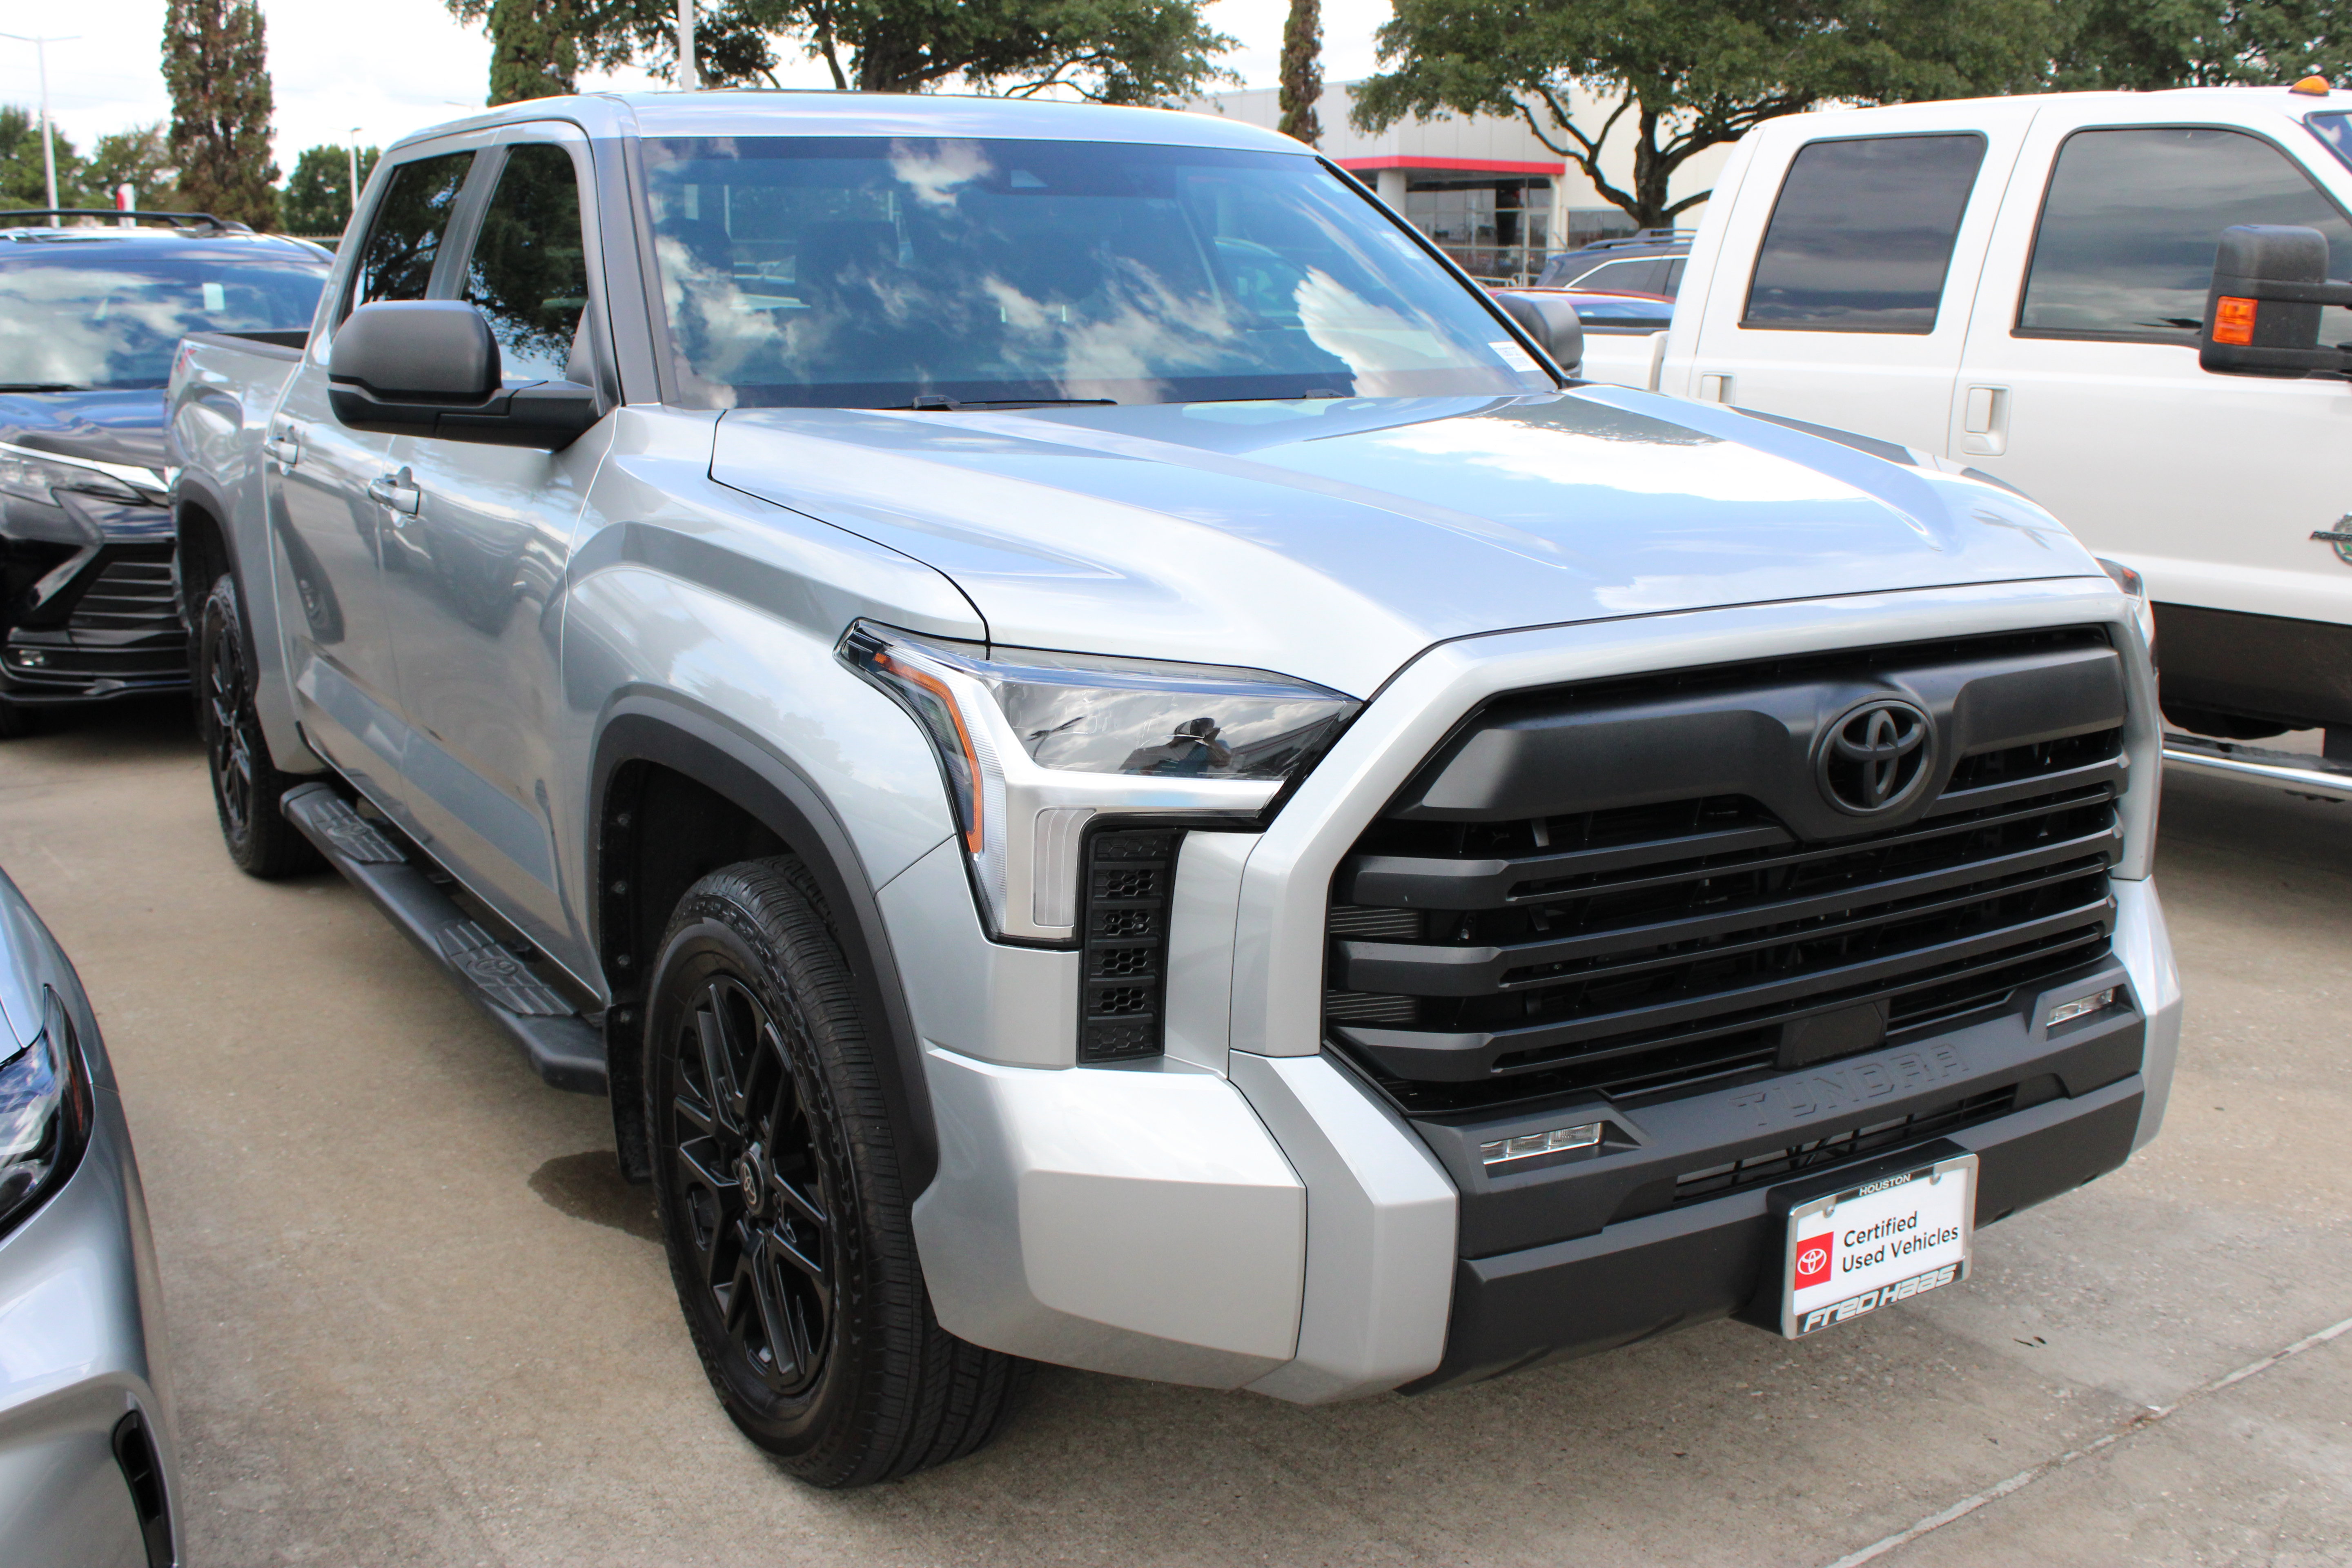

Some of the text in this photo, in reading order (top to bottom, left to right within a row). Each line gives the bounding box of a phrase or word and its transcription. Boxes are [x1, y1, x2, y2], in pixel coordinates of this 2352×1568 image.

[1728, 1043, 1971, 1127] TUNDRA
[1859, 1173, 1911, 1196] HOUSTON
[1842, 1226, 1959, 1273] Used Vehicles
[1844, 1210, 1918, 1247] Certified
